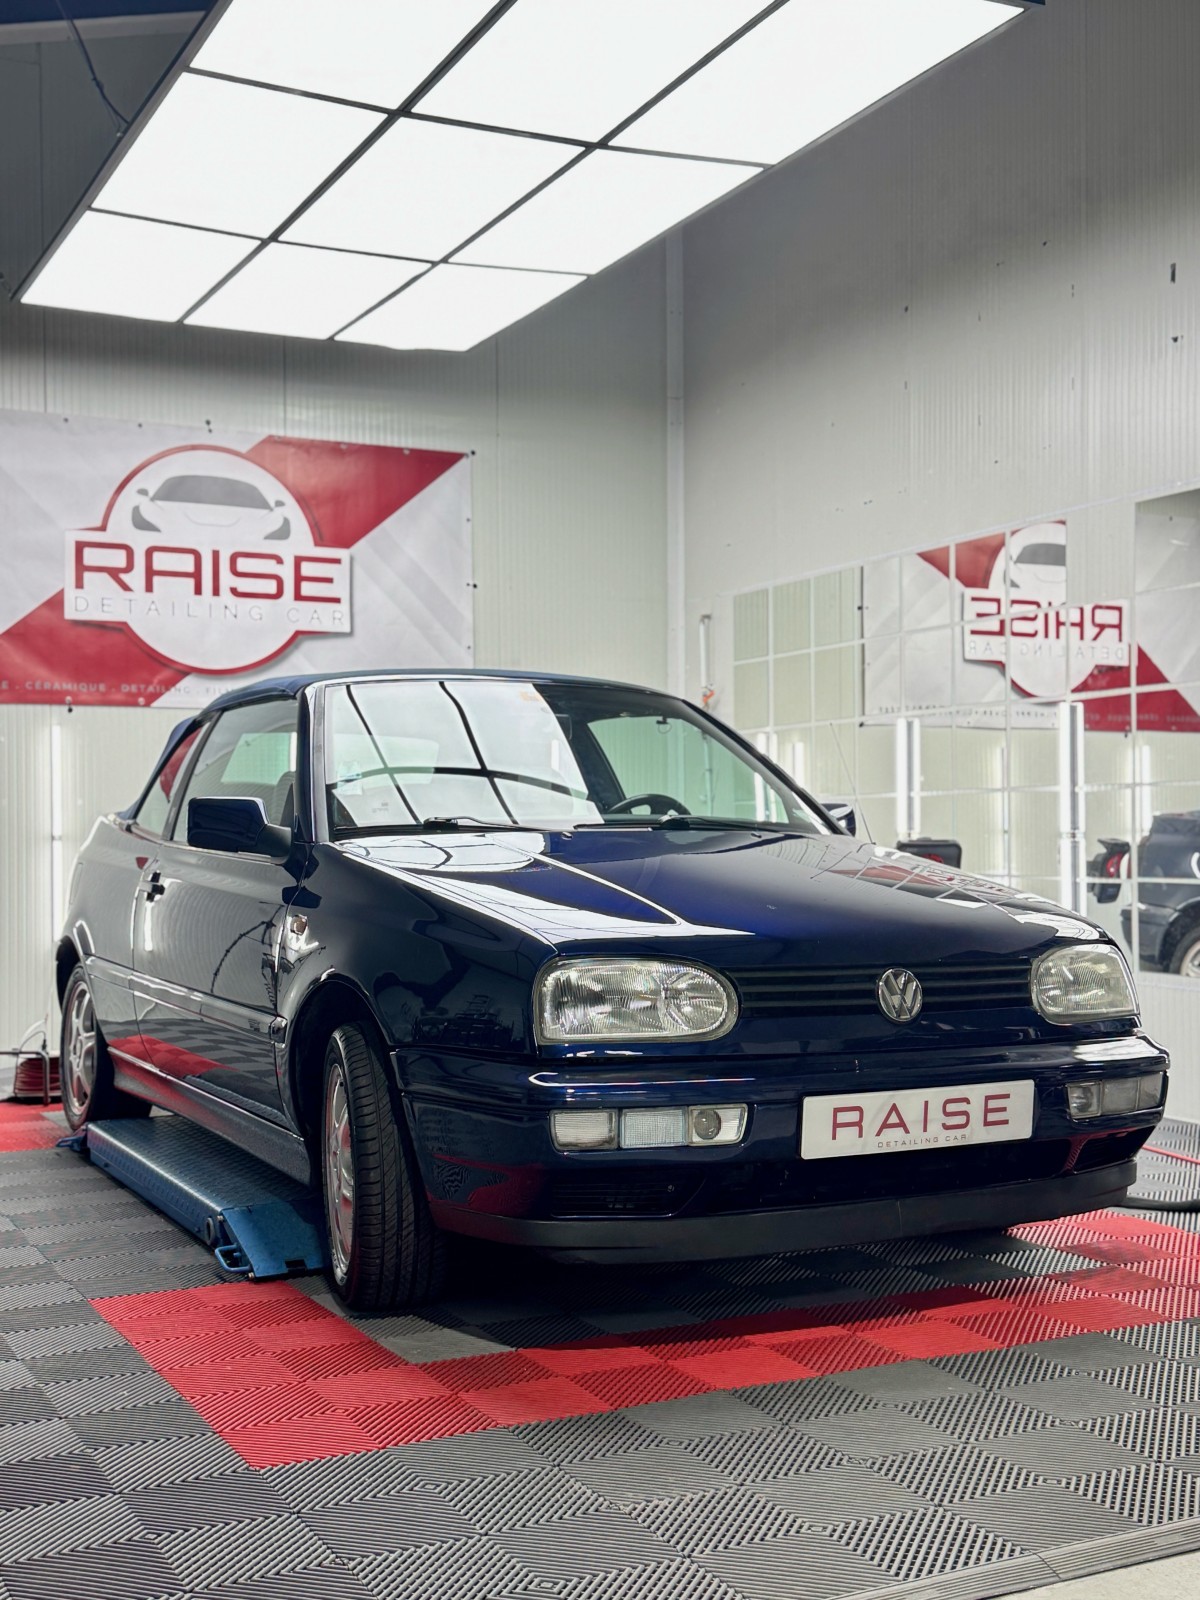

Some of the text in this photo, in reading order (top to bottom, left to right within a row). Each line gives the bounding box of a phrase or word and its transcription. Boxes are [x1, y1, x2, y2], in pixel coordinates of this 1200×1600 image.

[75, 540, 342, 604] RAISE
[74, 595, 346, 627] DETAILING CAR
[831, 1093, 1011, 1141] RAISE
[877, 1133, 967, 1148] DETAILING CAR
